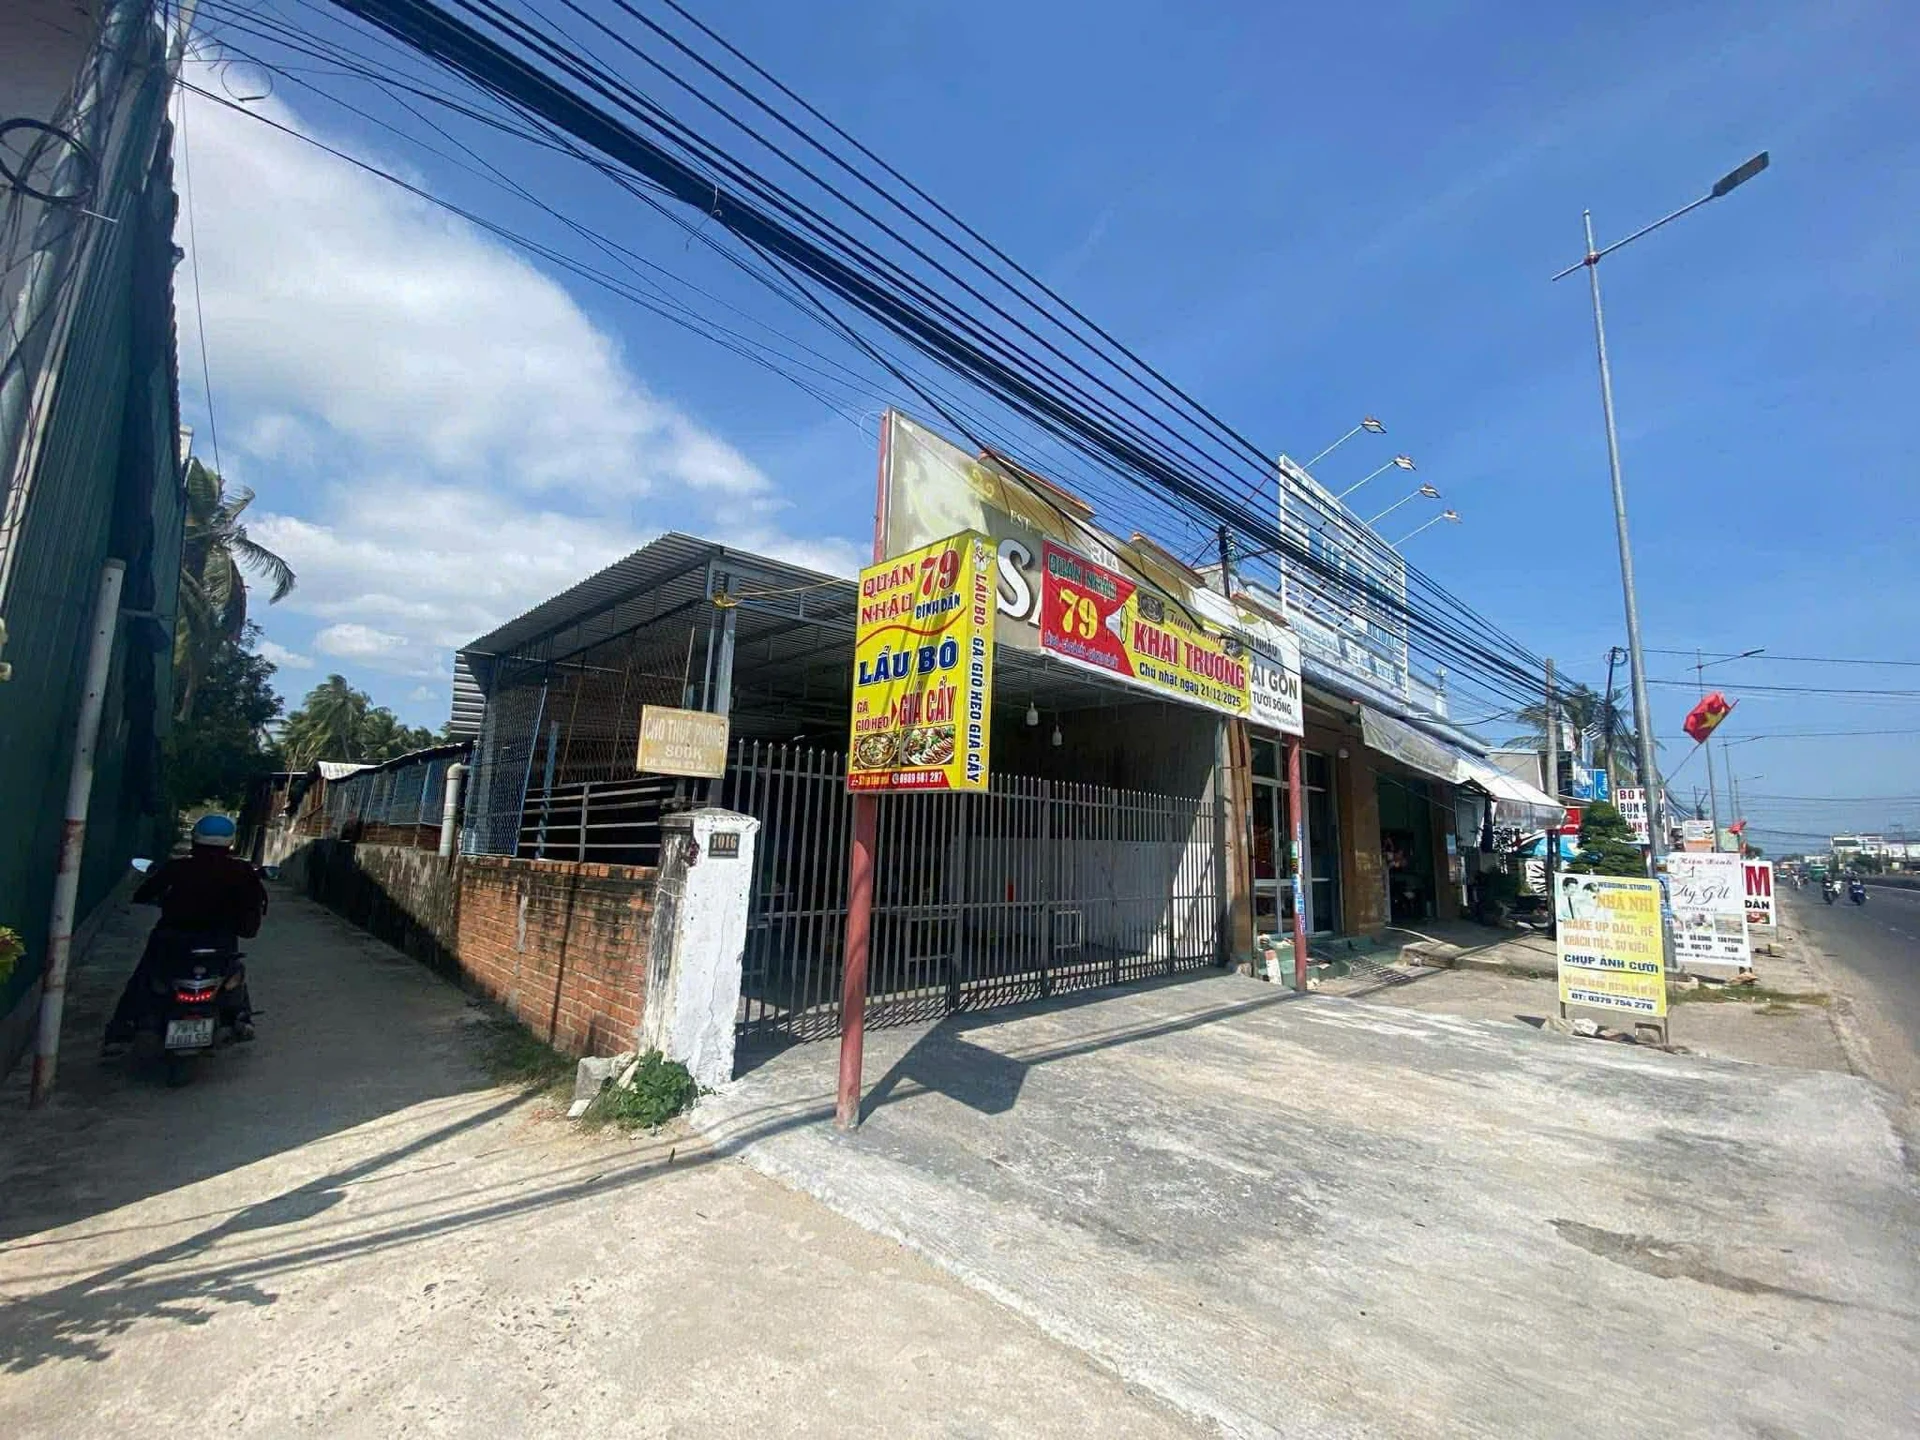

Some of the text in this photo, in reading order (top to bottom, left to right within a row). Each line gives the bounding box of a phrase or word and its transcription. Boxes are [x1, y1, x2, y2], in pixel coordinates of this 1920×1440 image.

[863, 563, 915, 598] QUÁN
[920, 549, 960, 596] 79
[1048, 552, 1083, 588] QUÁN
[861, 591, 914, 625] NHẬU
[1059, 587, 1098, 640] 79
[858, 636, 959, 686] LẨU BÒ
[1133, 619, 1178, 668] KHAI
[1183, 640, 1247, 693] TRƯƠNG
[1250, 655, 1298, 700] ÀI GÒN
[871, 716, 889, 730] HEO
[970, 690, 983, 721] HEO
[1563, 919, 1592, 931] MAKE
[1595, 921, 1609, 932] UP
[1564, 954, 1659, 973] CHỤP ẢNH CƯỚI
